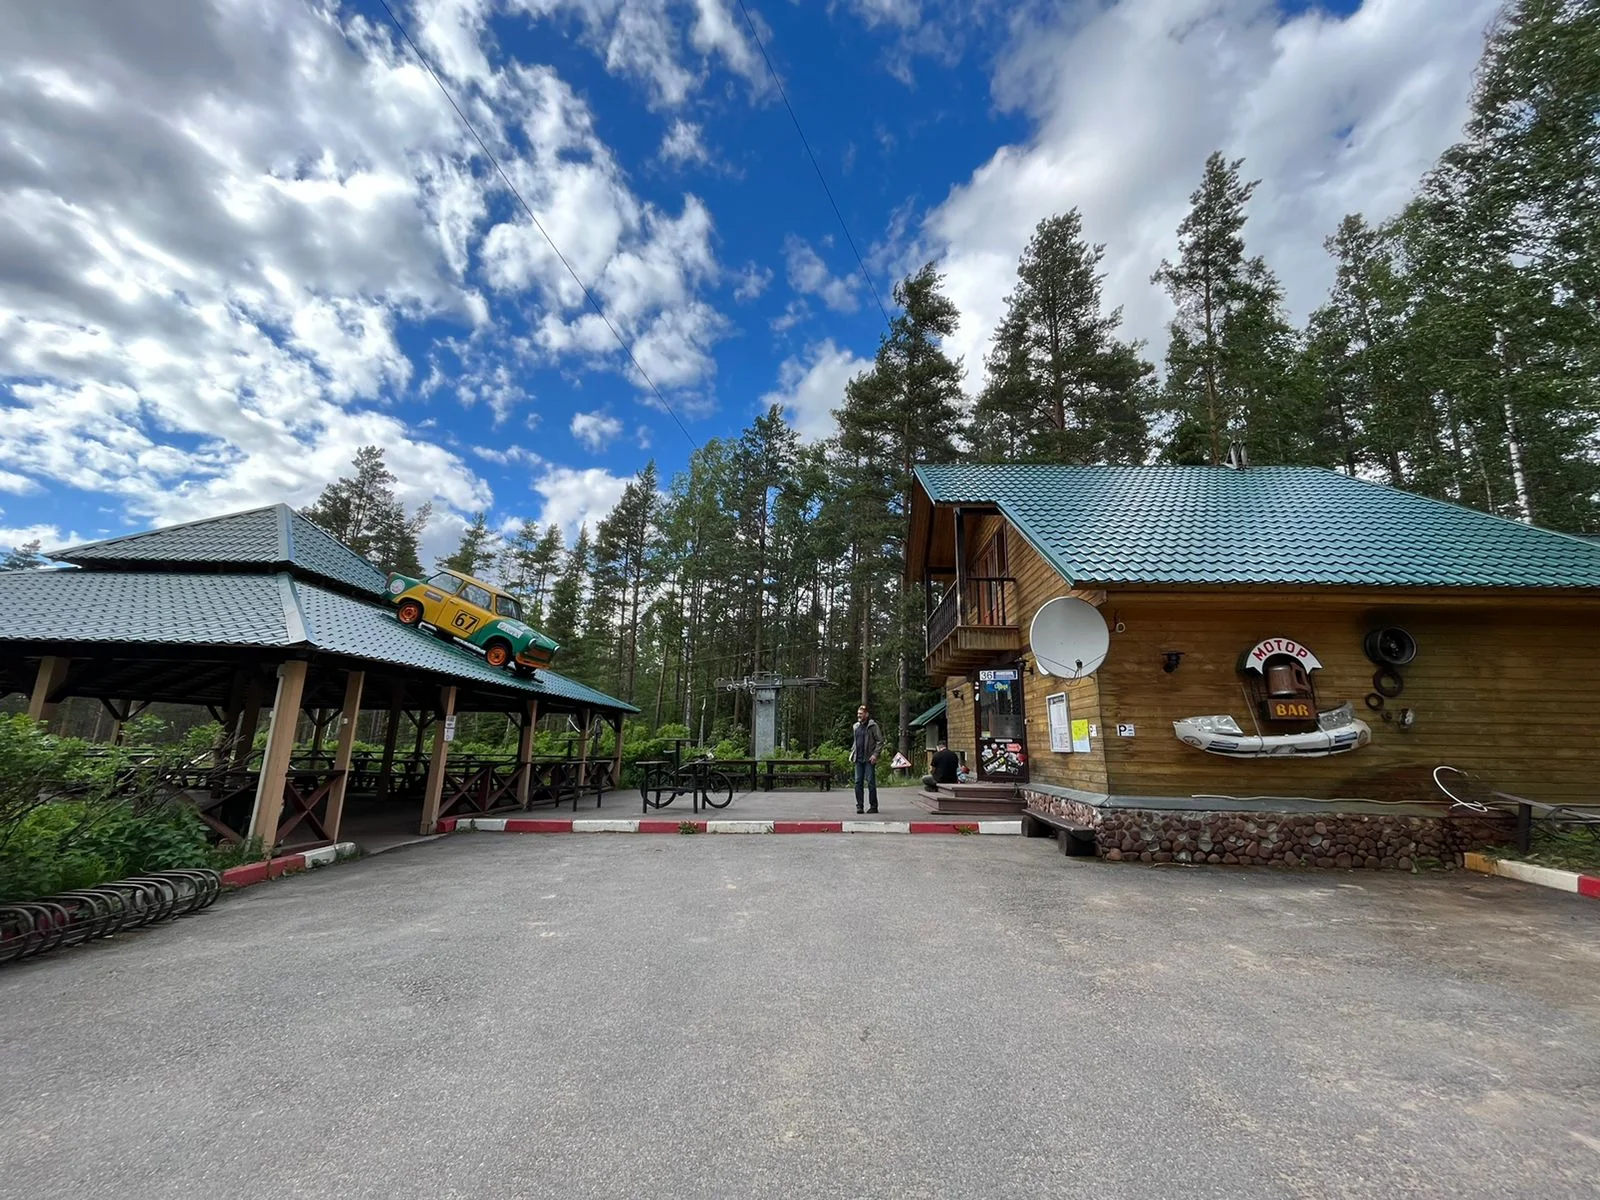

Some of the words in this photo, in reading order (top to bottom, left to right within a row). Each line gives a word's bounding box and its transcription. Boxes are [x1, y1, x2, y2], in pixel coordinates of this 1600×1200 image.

[455, 613, 477, 630] 67
[1253, 640, 1308, 661] МОТОР
[981, 671, 992, 680] 36
[1276, 703, 1309, 716] BAR
